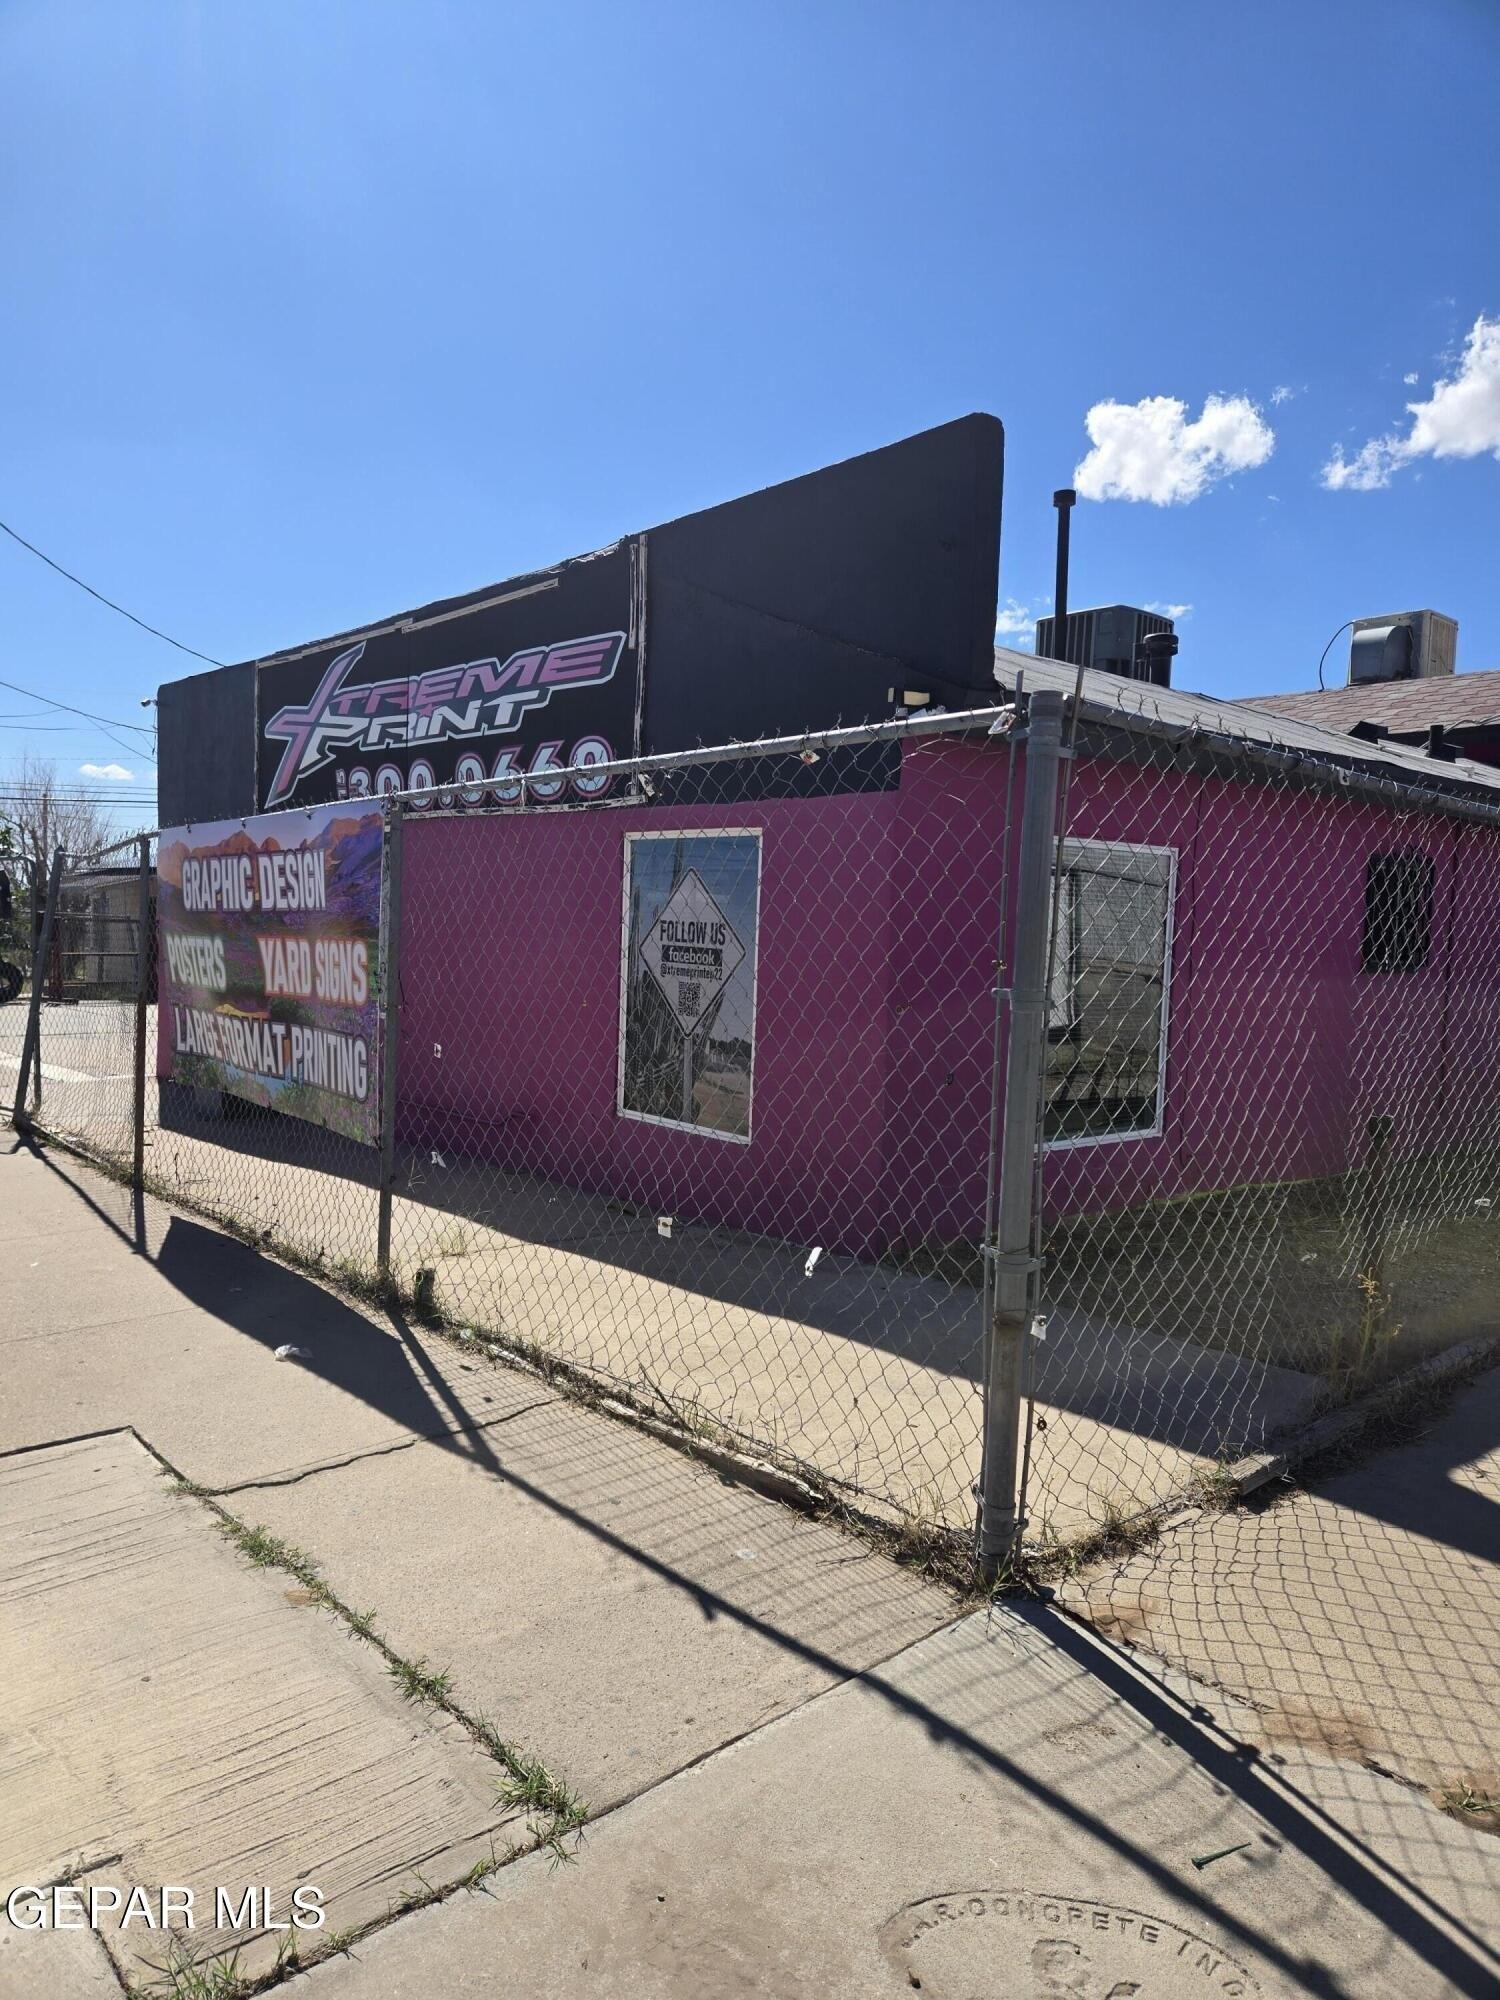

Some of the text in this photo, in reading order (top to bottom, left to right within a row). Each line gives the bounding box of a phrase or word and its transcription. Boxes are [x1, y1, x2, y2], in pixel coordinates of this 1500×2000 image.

[265, 631, 627, 809] XTREME
[182, 848, 327, 911] GRAPHIC DESIGN
[660, 919, 726, 946] FOLLOW US
[668, 946, 715, 965] facebook
[165, 935, 368, 1006] POSTERS YARD SIGNS
[173, 1006, 369, 1101] LARGE FORMAT PRINTING
